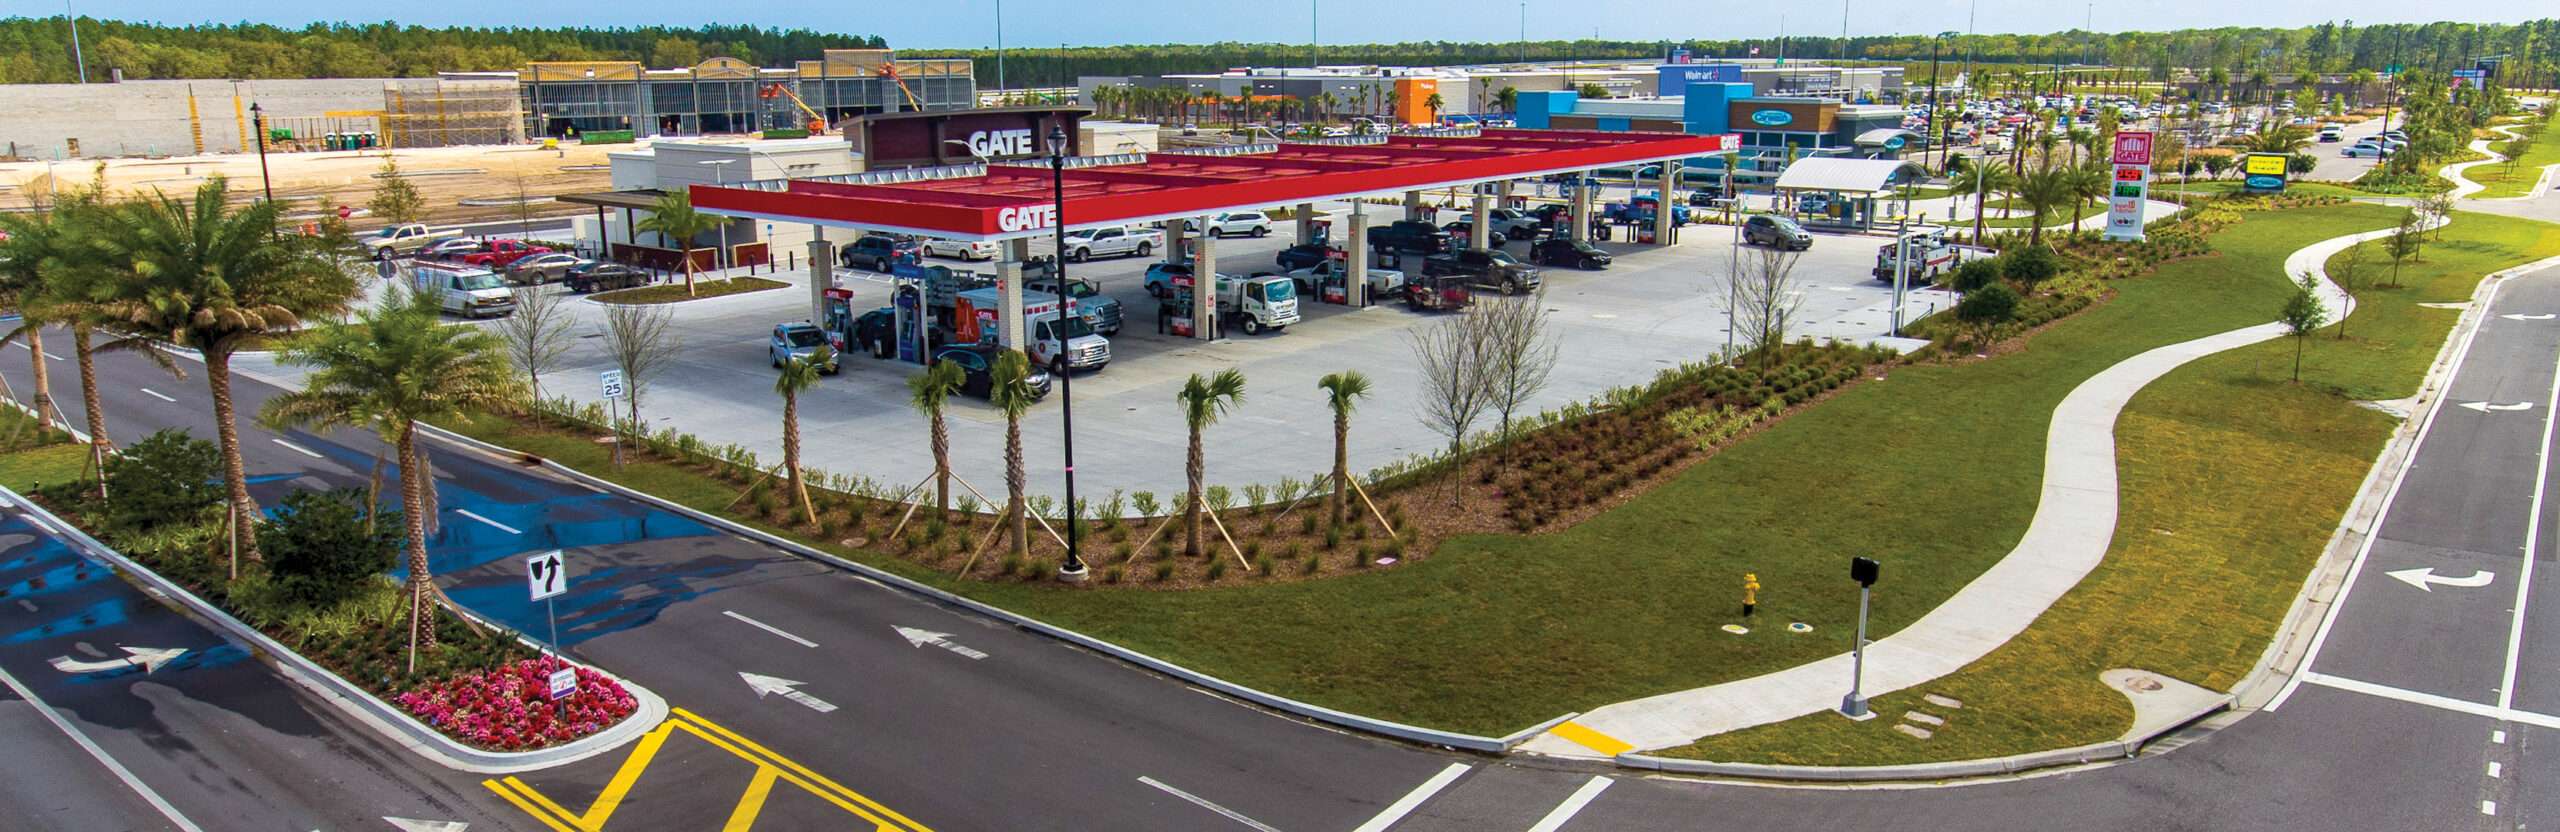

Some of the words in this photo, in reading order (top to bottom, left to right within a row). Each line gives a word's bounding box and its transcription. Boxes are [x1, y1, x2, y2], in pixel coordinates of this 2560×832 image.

[1684, 71, 1713, 80] Walmart
[970, 129, 1032, 157] GATE
[1720, 134, 1741, 150] GATE
[2118, 151, 2146, 161] GATE
[998, 203, 1057, 232] GATE
[604, 383, 621, 396] 25
